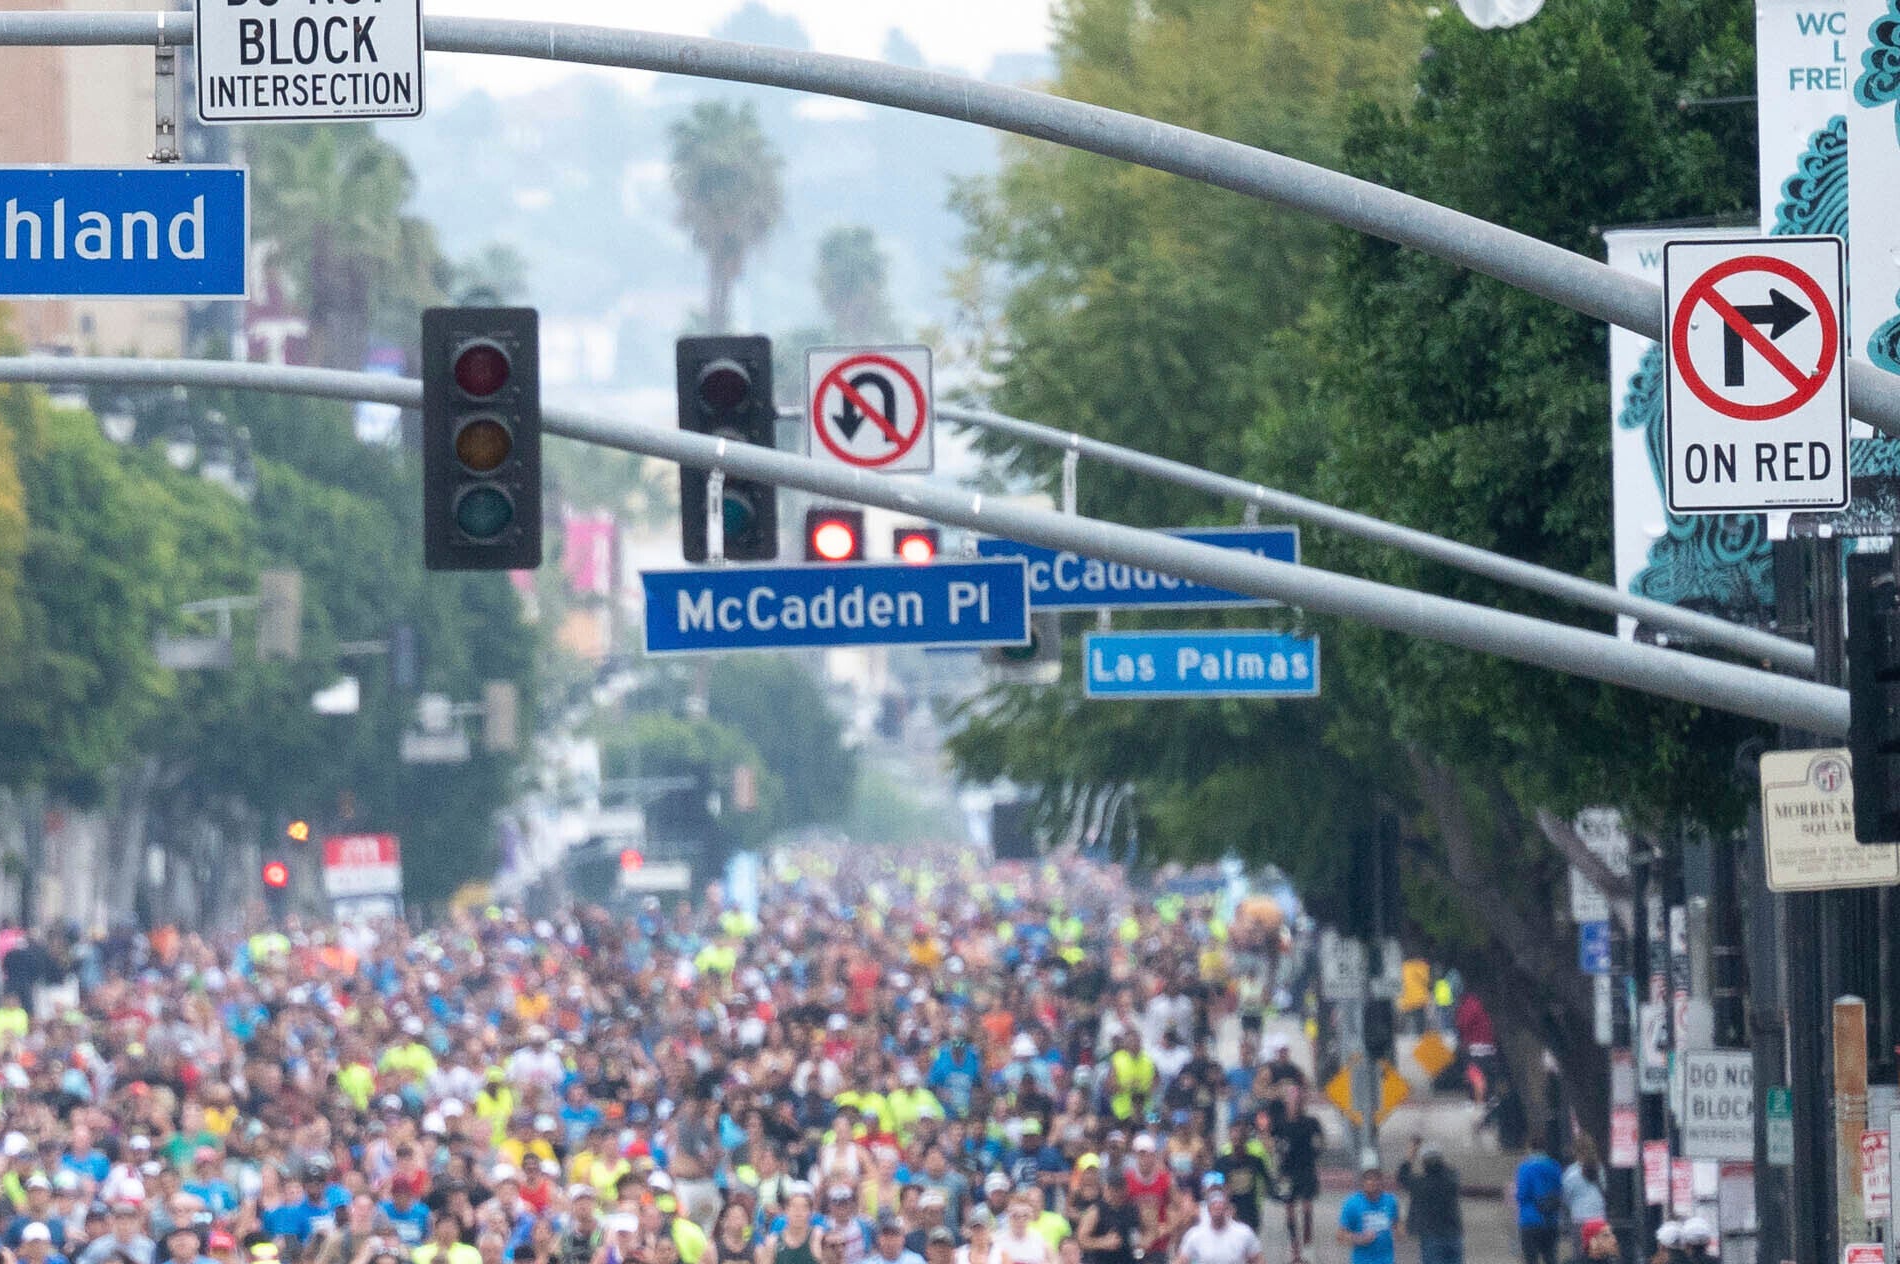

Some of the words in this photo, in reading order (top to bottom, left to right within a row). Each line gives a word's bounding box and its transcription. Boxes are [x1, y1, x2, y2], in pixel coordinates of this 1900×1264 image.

[238, 15, 379, 65] BLOCK
[208, 71, 412, 108] INTERSECTION
[1789, 67, 1847, 91] FRE
[1684, 443, 1737, 484] ON
[1755, 441, 1832, 482] RED
[676, 585, 925, 633] McCadden
[948, 581, 990, 624] Pl
[1092, 650, 1156, 682] Las
[1177, 647, 1309, 681] Palmas
[1773, 801, 1835, 819] MORRIS
[1800, 821, 1852, 837] SQUAR
[1689, 1063, 1717, 1088] DO
[1724, 1062, 1753, 1088] NO
